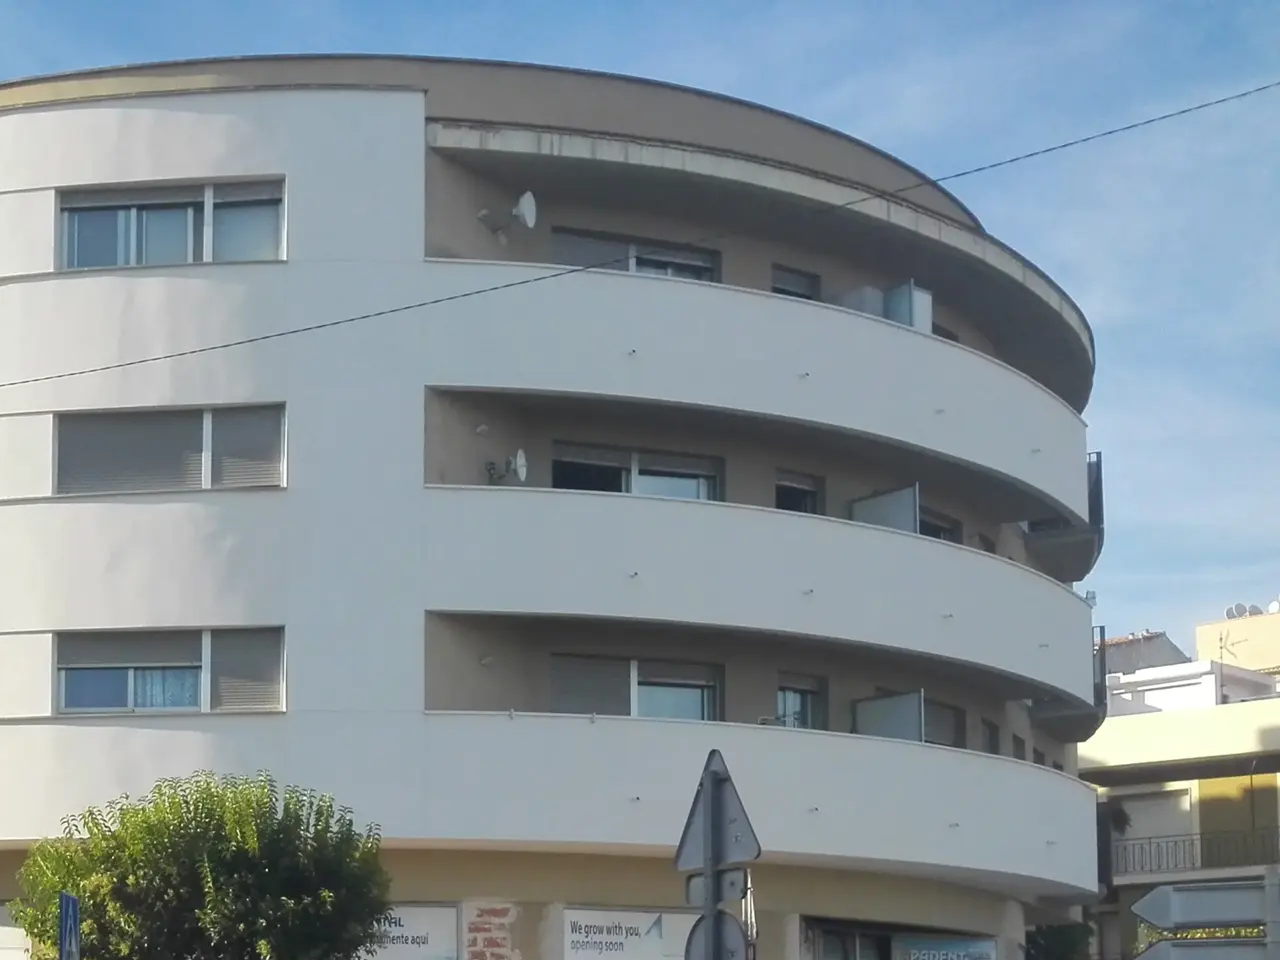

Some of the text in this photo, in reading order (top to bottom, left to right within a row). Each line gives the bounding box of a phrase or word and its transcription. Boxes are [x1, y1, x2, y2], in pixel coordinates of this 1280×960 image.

[570, 920, 641, 939] We grow with you,
[570, 937, 624, 955] opening soon
